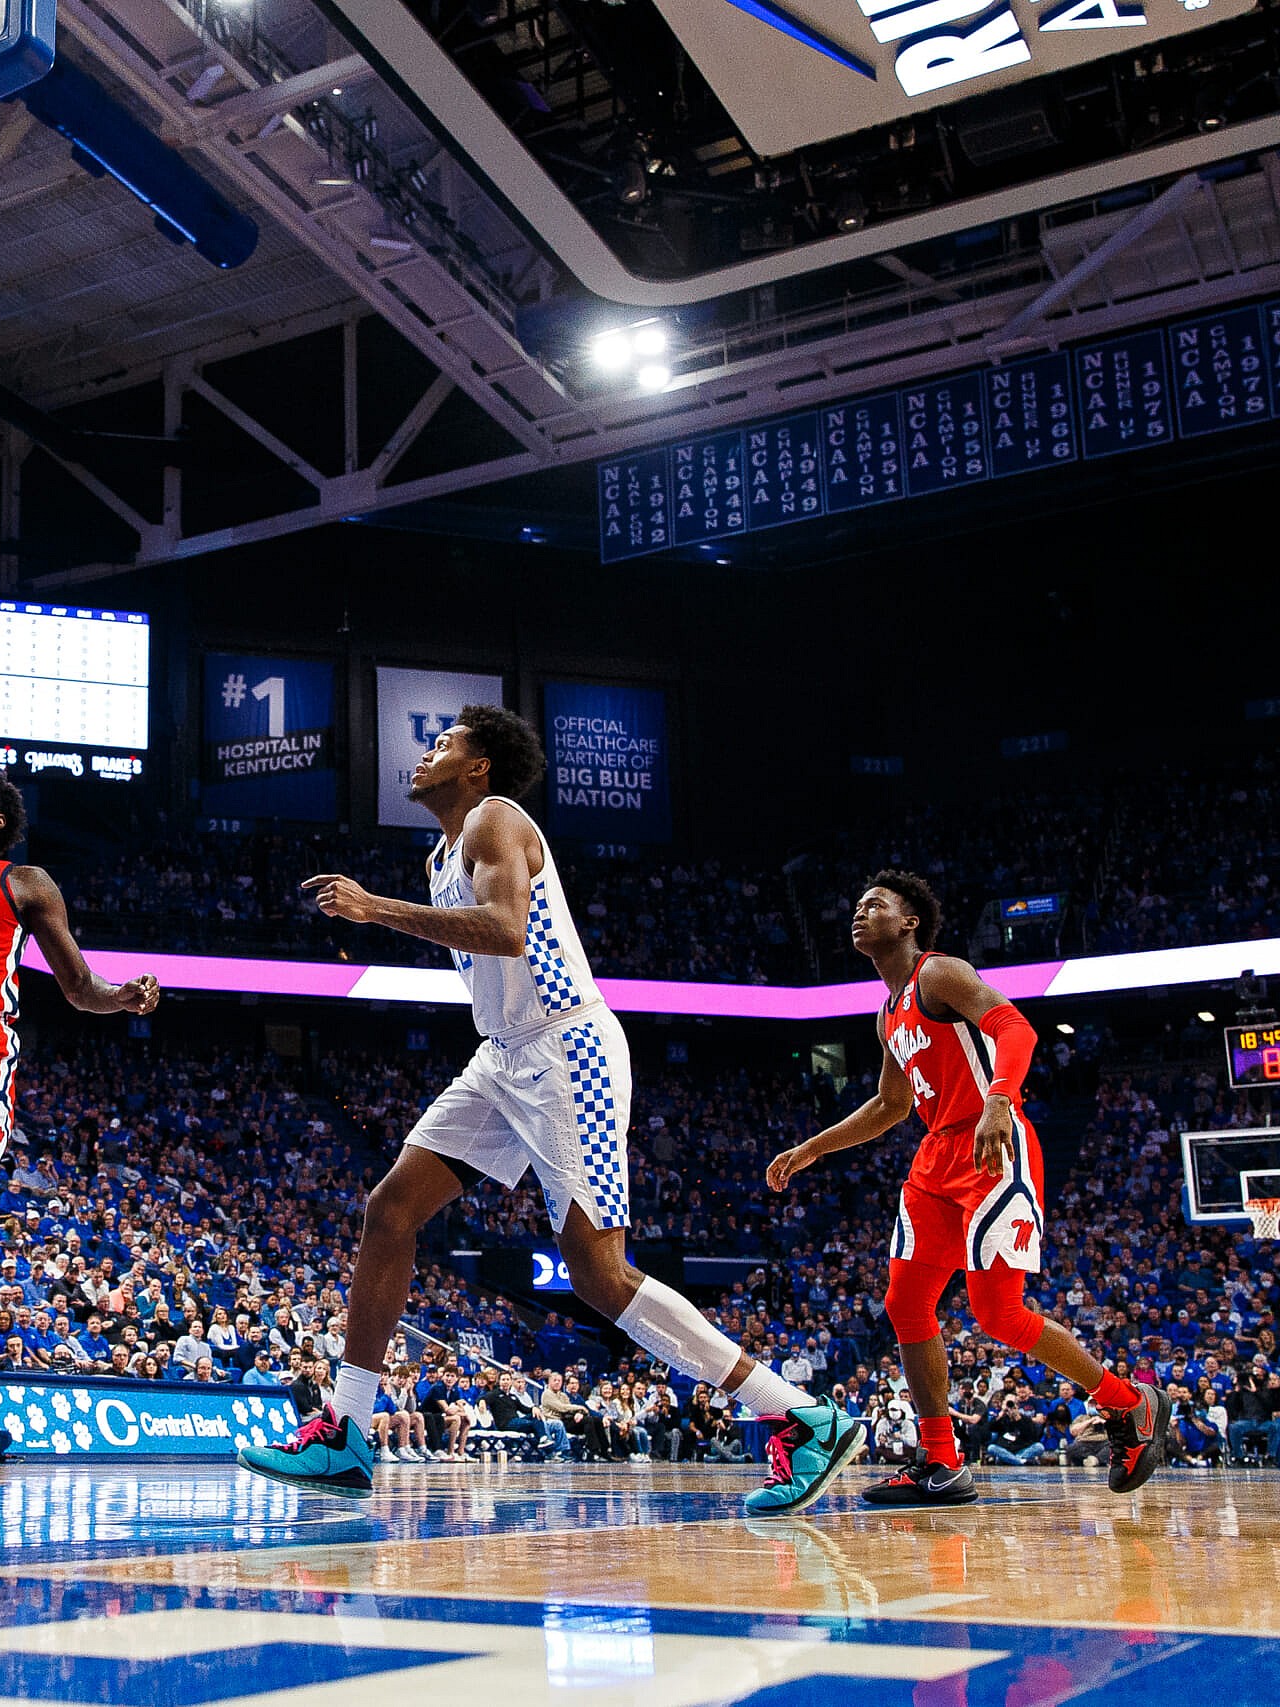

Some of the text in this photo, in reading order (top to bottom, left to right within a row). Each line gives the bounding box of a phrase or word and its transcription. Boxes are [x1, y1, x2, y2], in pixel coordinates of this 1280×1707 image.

[1083, 352, 1109, 430] NCAA
[1142, 361, 1165, 437] 1975
[1178, 328, 1206, 408] NCAA
[1240, 335, 1265, 414] 1978
[908, 392, 929, 468] NCAA
[963, 401, 983, 475] 1958
[992, 372, 1013, 448] NCAA
[1050, 383, 1070, 458] 1966
[677, 446, 693, 518] NCAA
[750, 432, 770, 504] NCAA
[800, 442, 818, 512] 1949
[828, 410, 848, 484] NCAA
[880, 422, 898, 494] 1951
[603, 467, 621, 537] NCAA
[649, 475, 665, 543] 1942
[725, 458, 742, 527] 1948
[222, 673, 285, 737] #1
[554, 715, 627, 735] OFFICIAL
[217, 734, 322, 760] HOSPITAL IN
[224, 752, 316, 776] KENTUCKY
[555, 733, 659, 754] HEALTHCARE
[555, 751, 655, 770] PARTNER OF
[557, 767, 652, 790] BIG BLUE
[557, 787, 642, 810] NATION
[140, 1411, 194, 1437] Central
[192, 1413, 232, 1437] Bank
